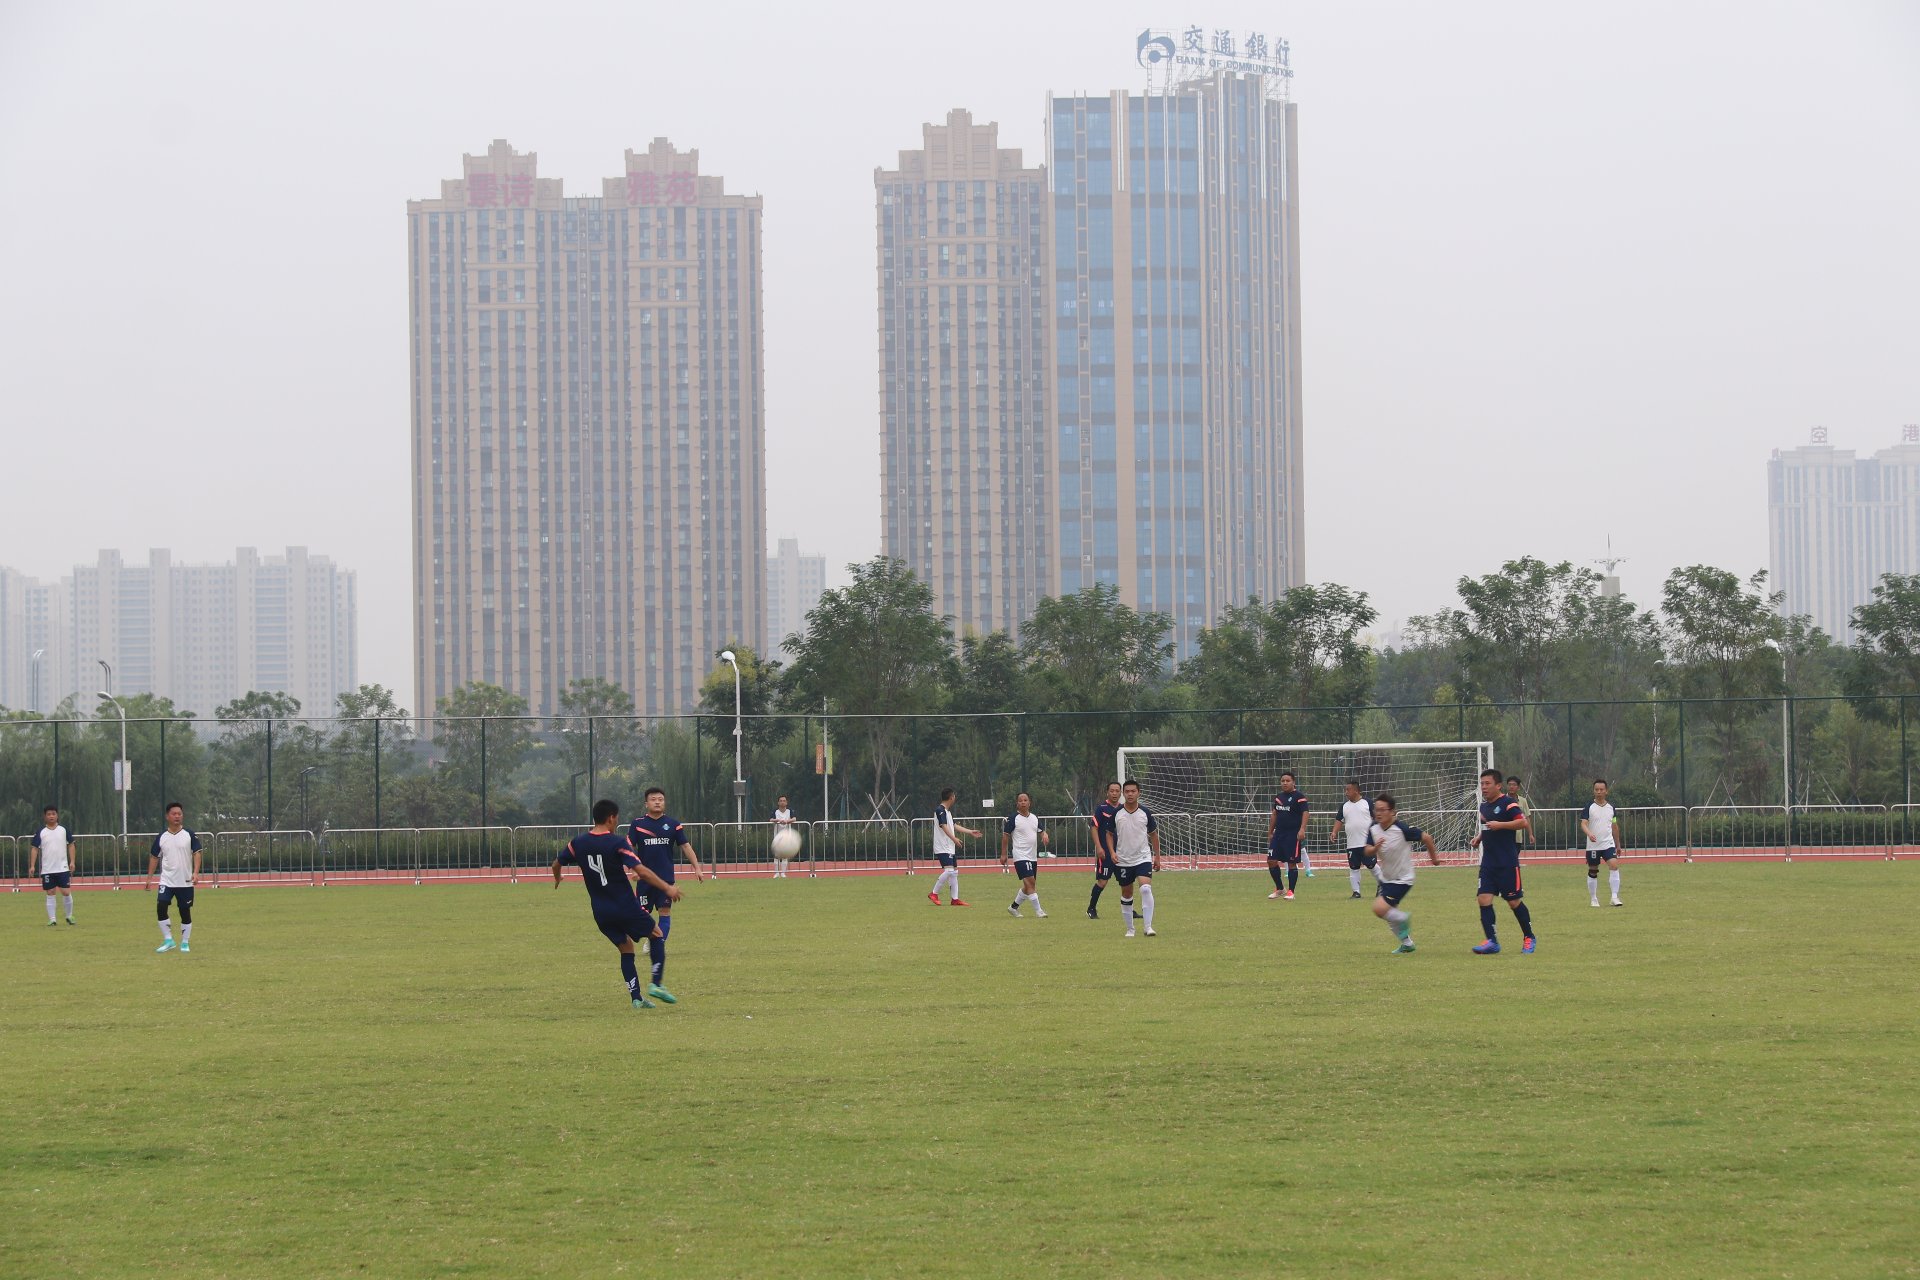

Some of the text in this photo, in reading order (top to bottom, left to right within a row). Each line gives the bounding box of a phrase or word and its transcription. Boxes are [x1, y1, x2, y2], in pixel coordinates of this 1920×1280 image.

[1184, 24, 1290, 67] 交通銀行
[1176, 56, 1294, 78] BANK OF COMMUNICATIONS
[1811, 425, 1828, 444] 空
[587, 854, 608, 887] 4
[1120, 868, 1126, 878] 2
